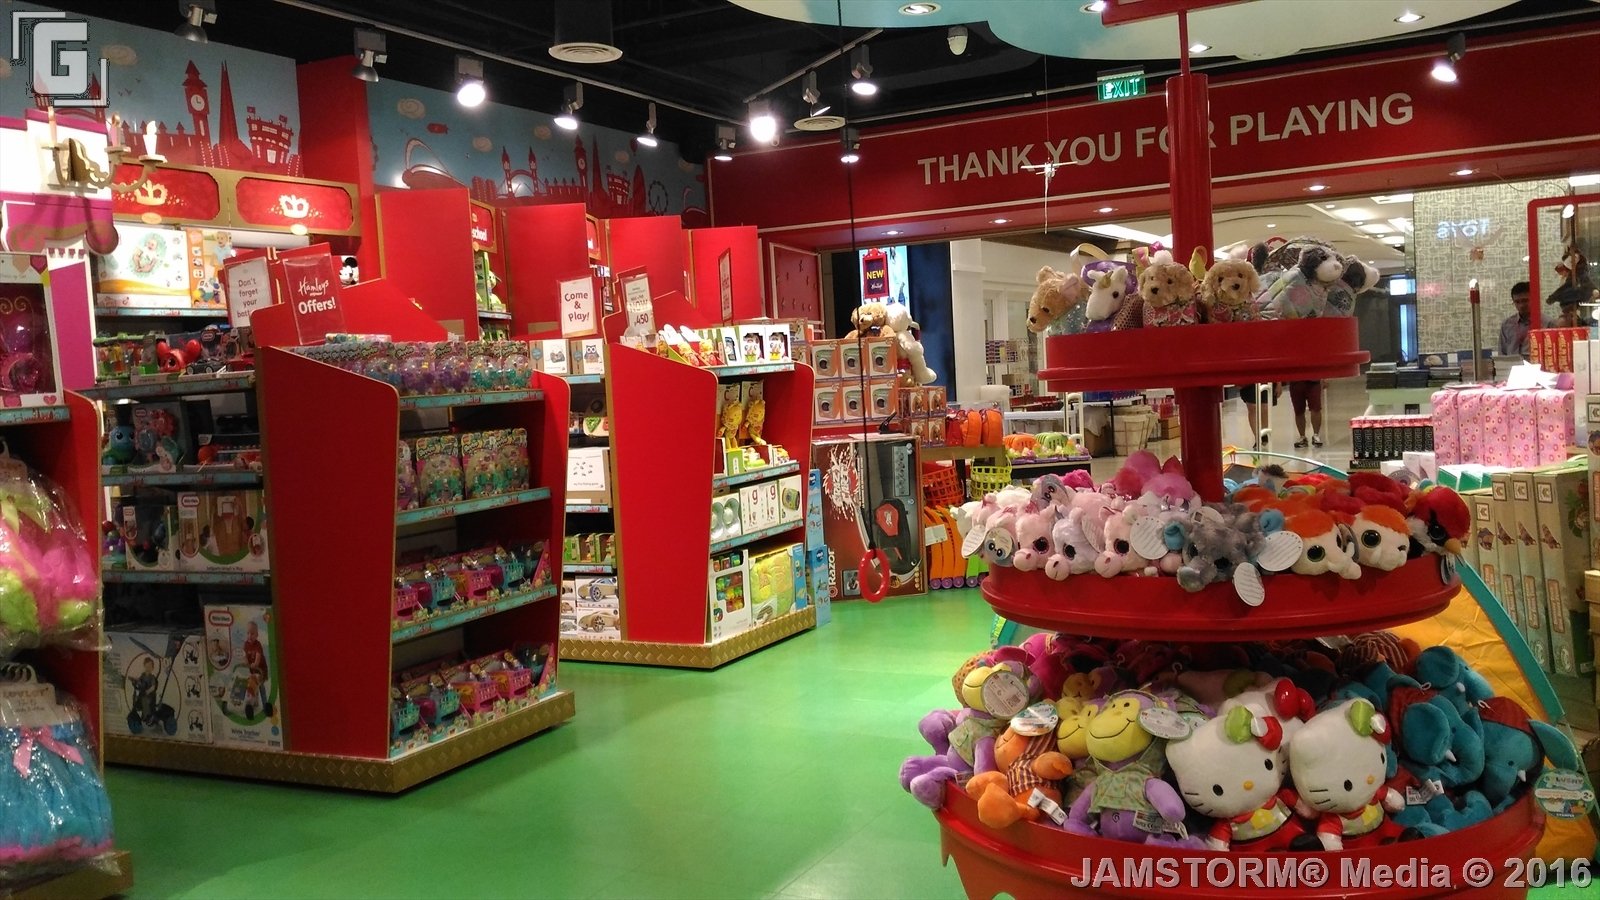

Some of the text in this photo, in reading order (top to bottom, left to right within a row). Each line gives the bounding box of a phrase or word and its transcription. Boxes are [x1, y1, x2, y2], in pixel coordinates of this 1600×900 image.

[1103, 78, 1140, 99] EXIT
[918, 144, 1035, 185] THANK
[1044, 132, 1121, 167] YOU
[1230, 92, 1414, 146] PLAYING
[471, 226, 488, 242] school
[866, 270, 884, 280] NEW
[238, 277, 257, 287] Don't
[298, 276, 329, 296] Hamleys
[239, 288, 258, 298] forget
[564, 291, 589, 302] Come
[242, 299, 258, 308] your
[298, 297, 336, 314] Offers!
[574, 301, 582, 309] &
[236, 309, 251, 318] batt
[568, 311, 590, 323] Play!
[828, 547, 836, 585] Razor
